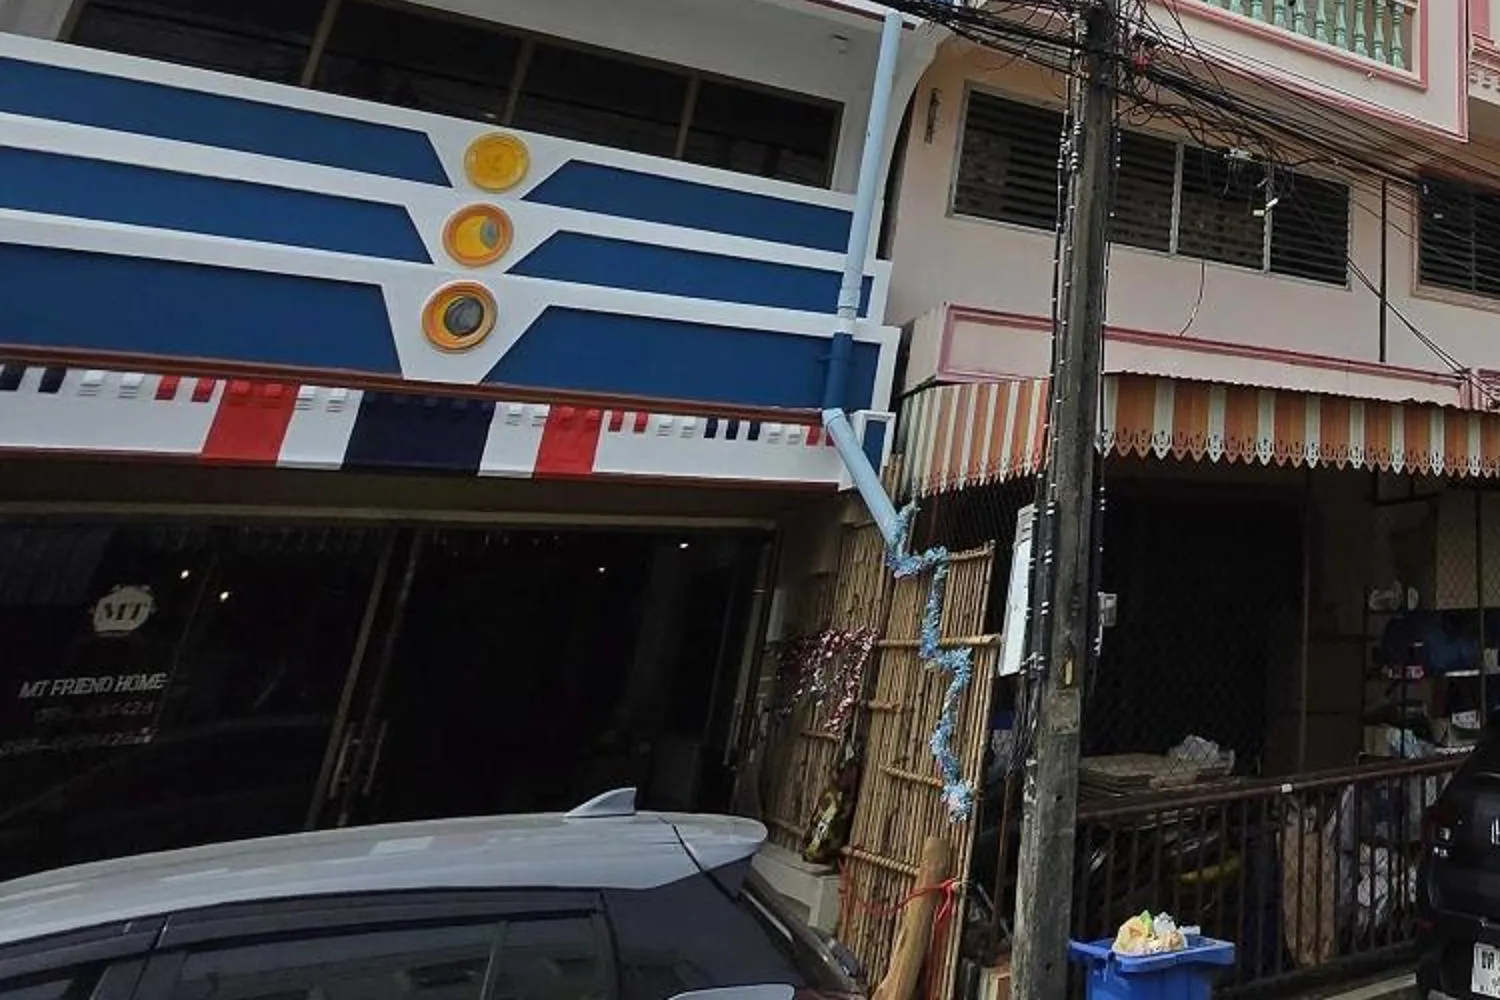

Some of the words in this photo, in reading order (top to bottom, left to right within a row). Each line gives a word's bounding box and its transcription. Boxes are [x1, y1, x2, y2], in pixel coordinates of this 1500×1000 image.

[18, 681, 50, 698] MT
[50, 676, 114, 696] FRIEND
[115, 673, 168, 692] HOME
